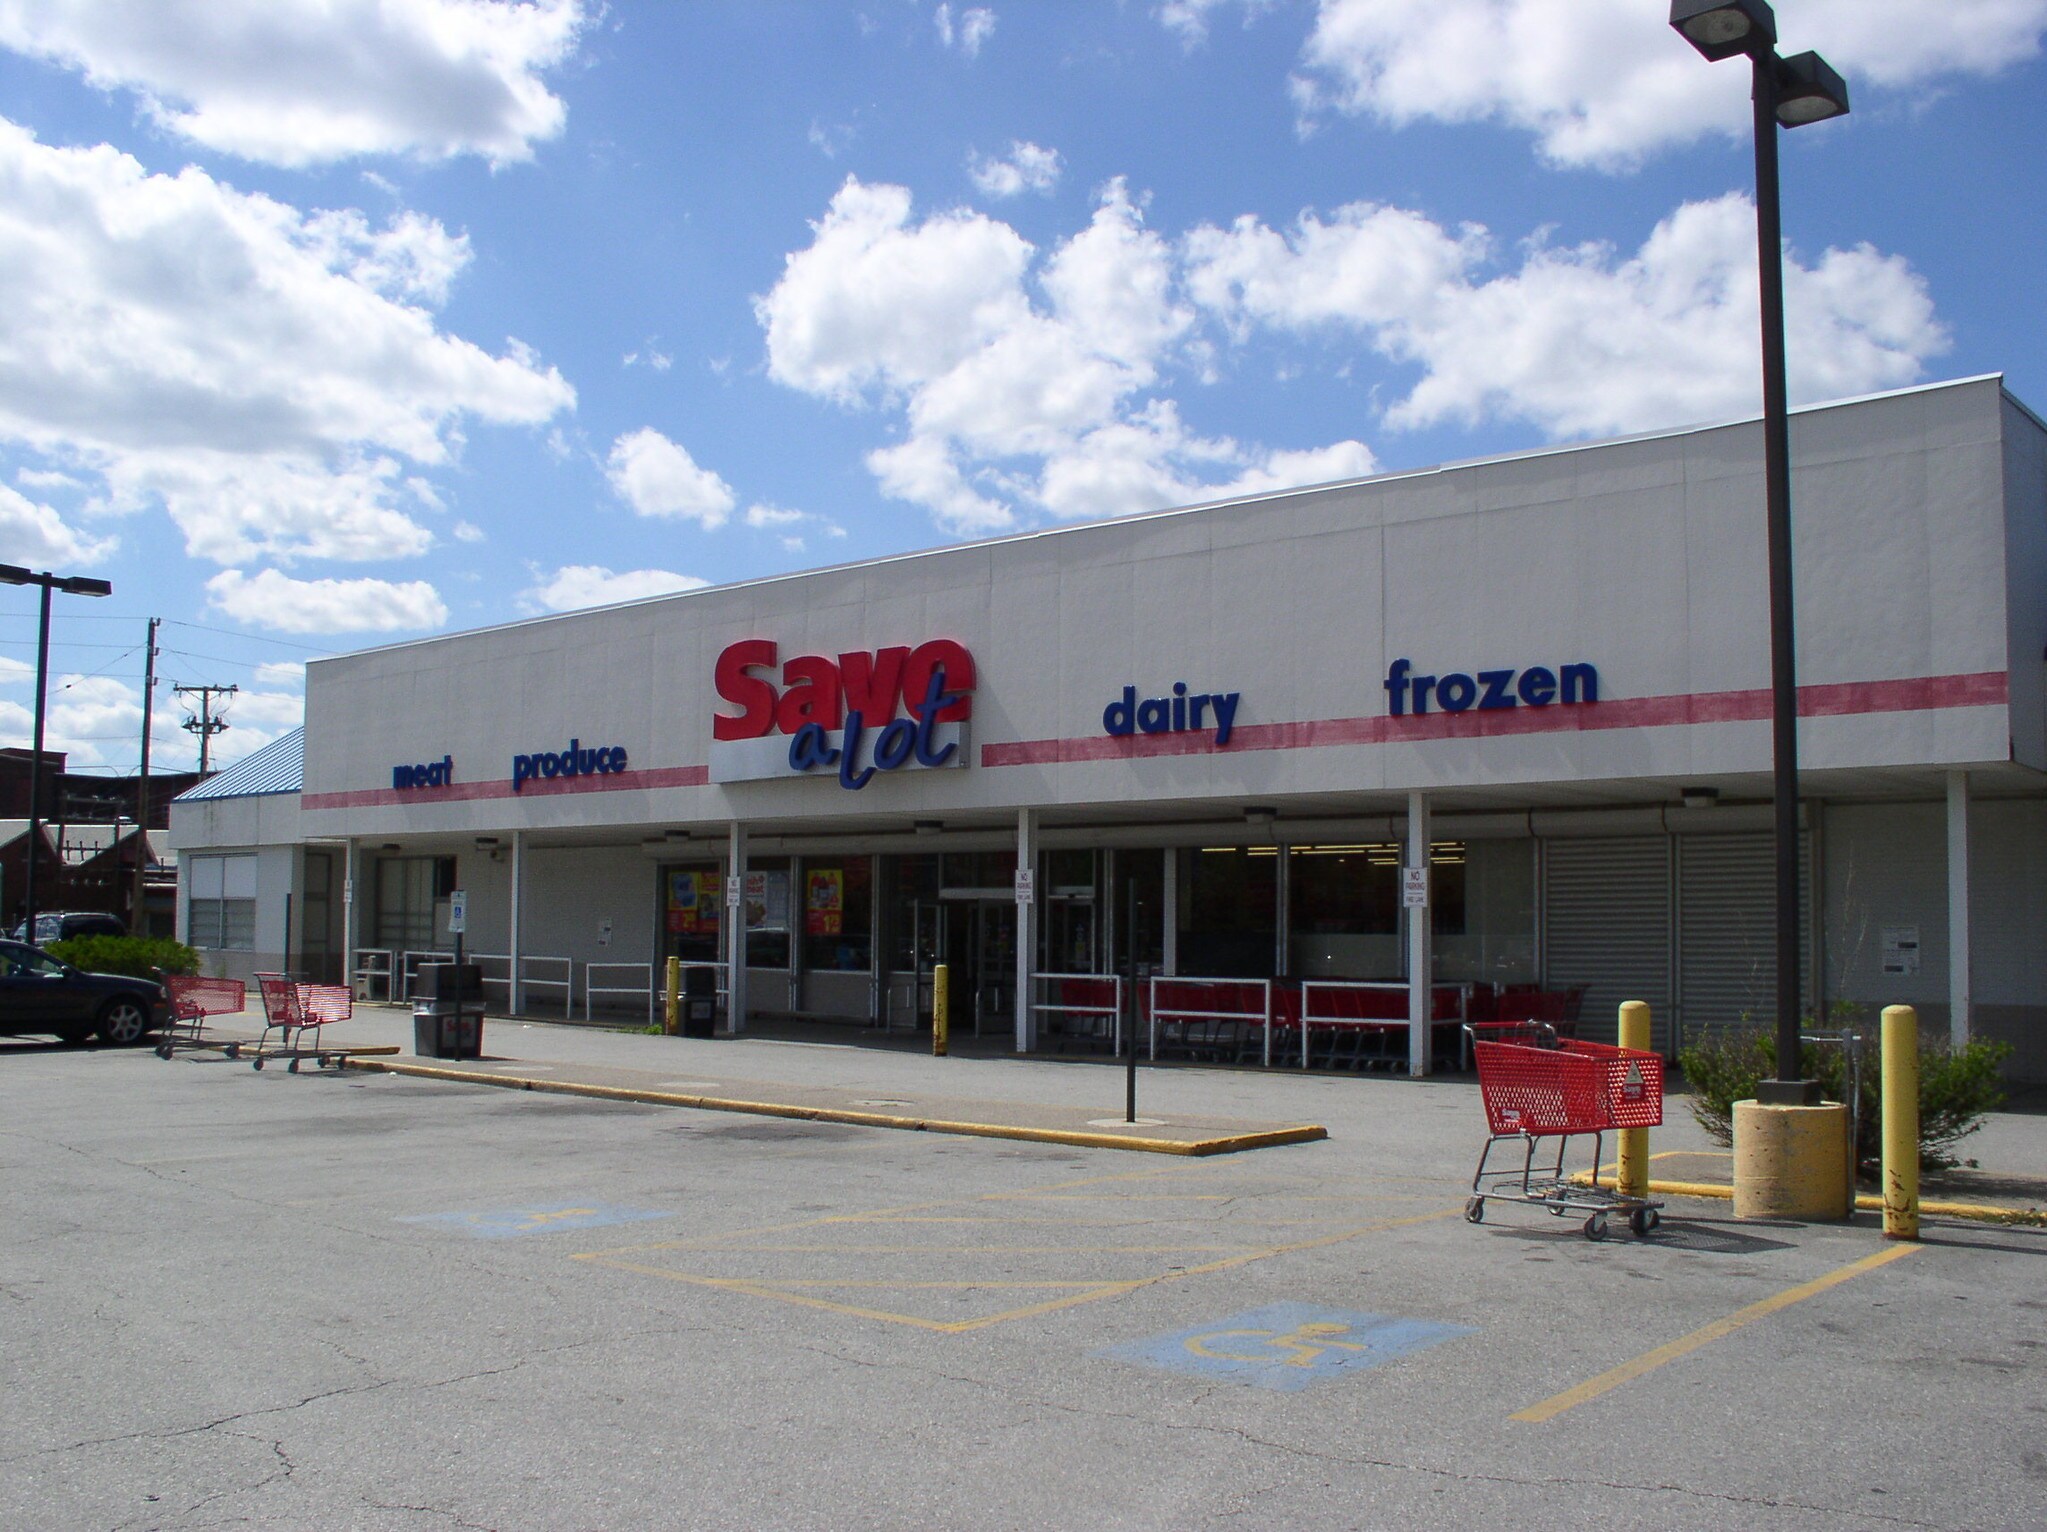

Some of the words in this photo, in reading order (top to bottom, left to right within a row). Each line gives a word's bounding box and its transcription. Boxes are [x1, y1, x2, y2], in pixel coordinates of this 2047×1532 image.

[713, 638, 977, 742] Save
[1102, 681, 1241, 746] dairy
[1383, 657, 1599, 716] frozen
[392, 754, 454, 791] meat
[512, 738, 628, 792] produce
[1406, 882, 1425, 890] PARKING
[1411, 871, 1420, 881] NO
